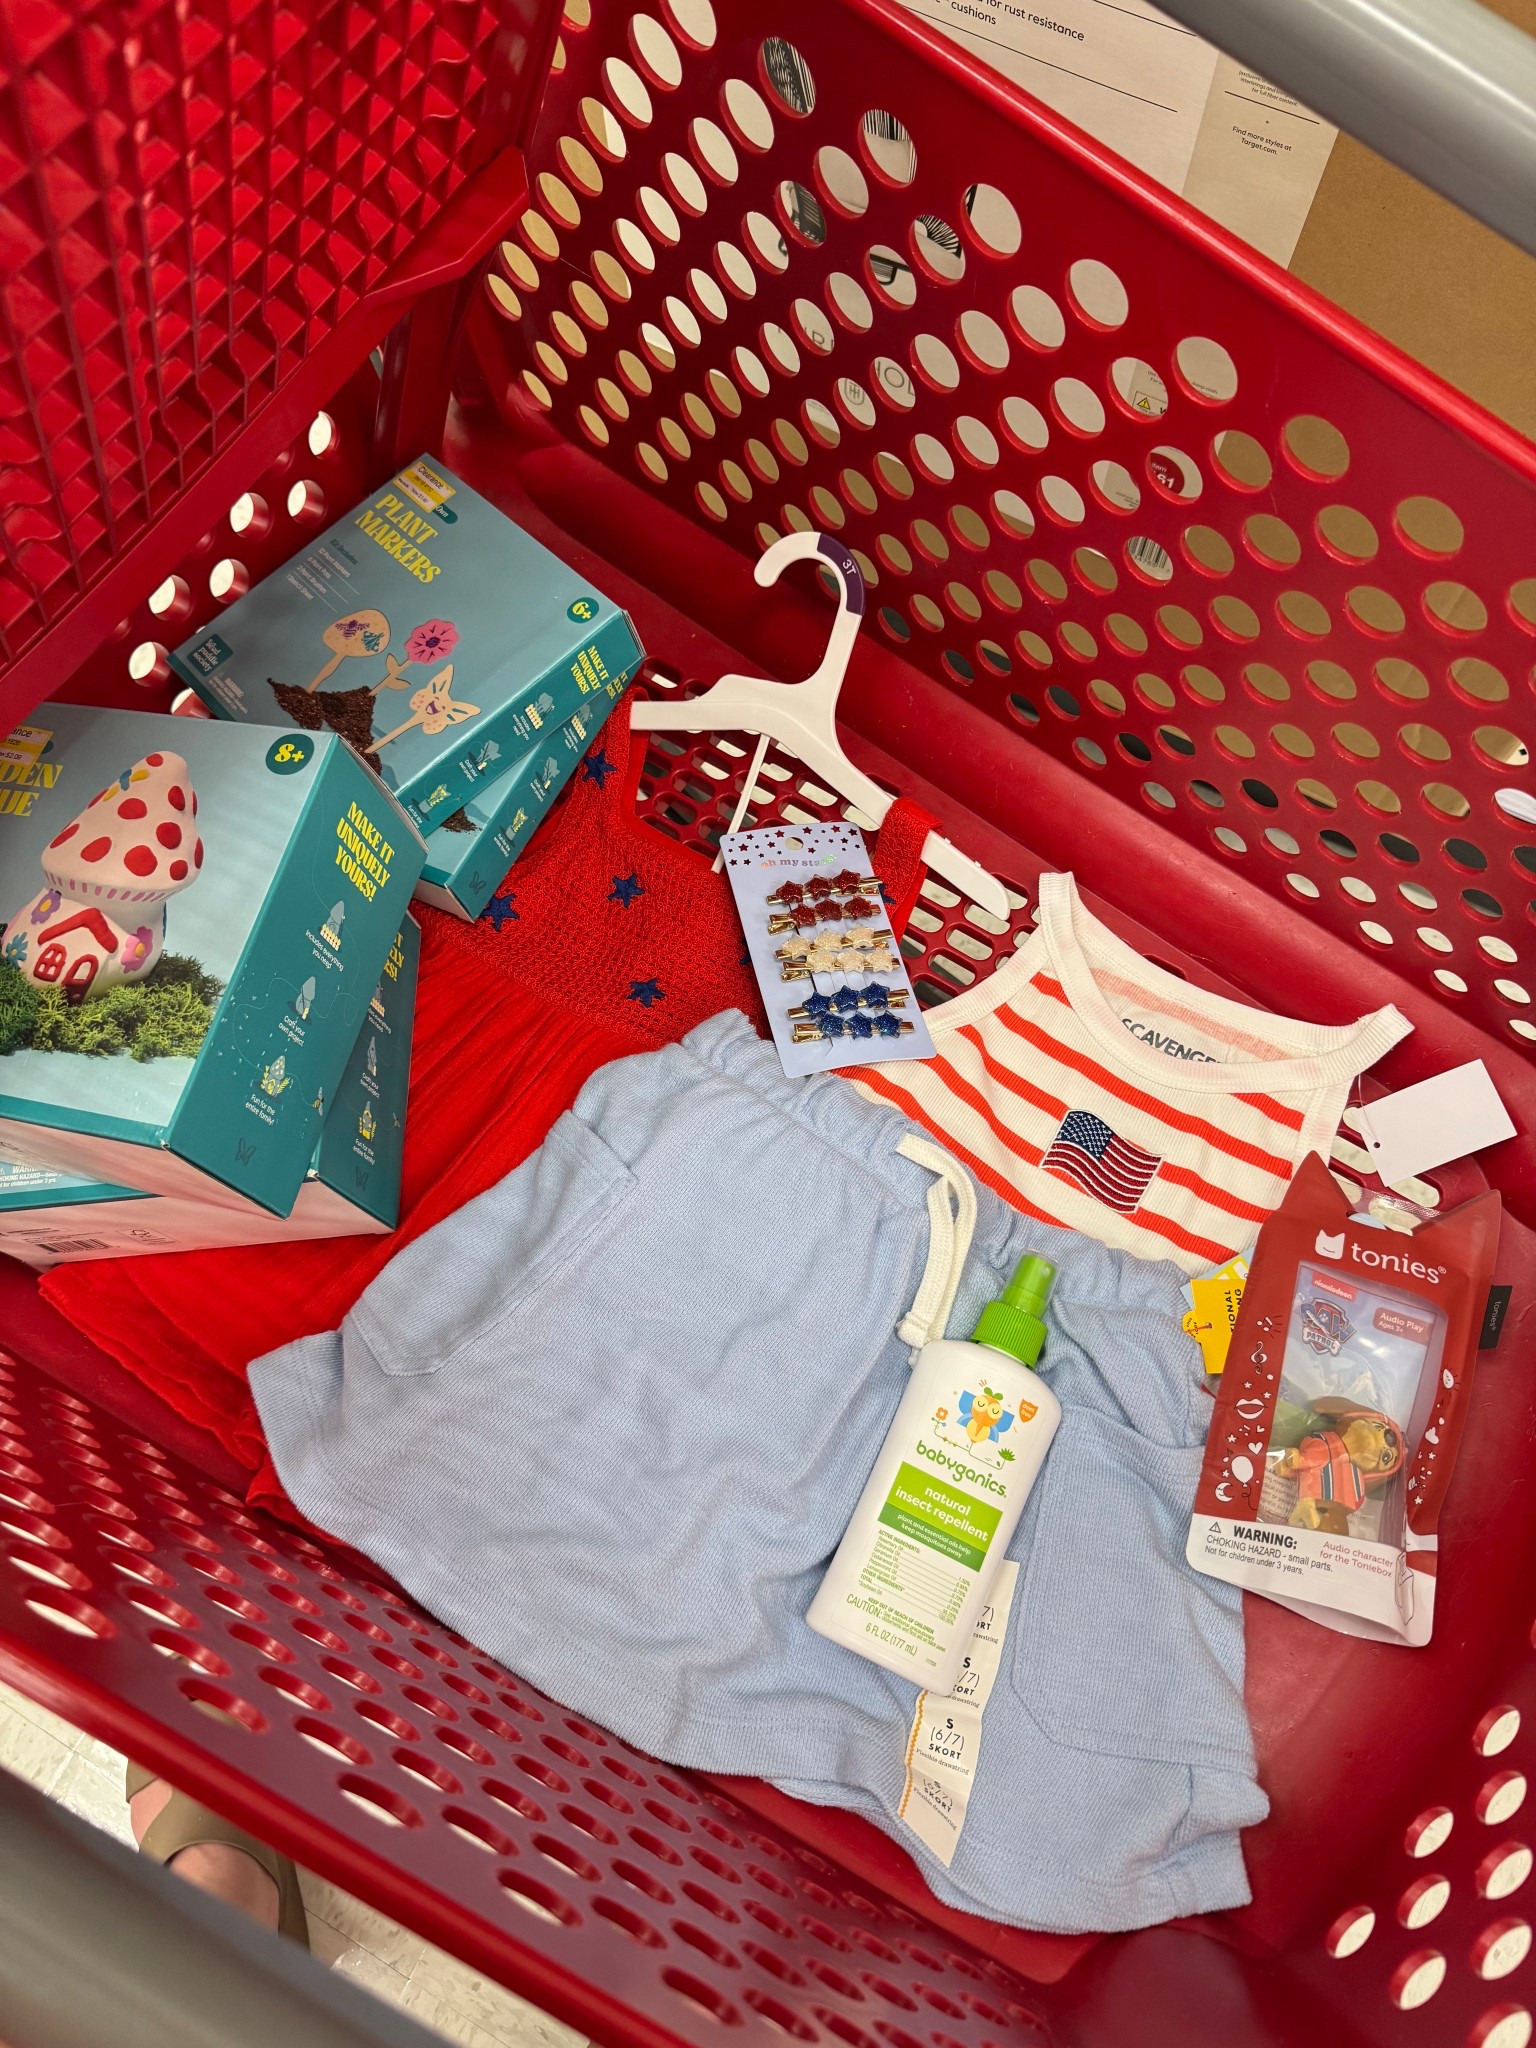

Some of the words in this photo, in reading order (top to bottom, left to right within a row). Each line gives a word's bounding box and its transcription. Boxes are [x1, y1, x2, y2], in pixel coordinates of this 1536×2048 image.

[951, 2, 996, 25] cushions
[1004, 4, 1025, 18] rust
[1028, 13, 1084, 42] resistance
[1232, 126, 1246, 135] Find
[1248, 132, 1264, 142] more
[1265, 138, 1283, 149] styles
[1241, 138, 1278, 155] Target.com.
[418, 466, 443, 489] Clearance
[375, 494, 438, 544] PLANT
[355, 510, 441, 582] MARKERS
[842, 559, 856, 574] 3T
[572, 601, 591, 619] 6+
[193, 652, 213, 672] society
[198, 647, 219, 666] puddle
[588, 645, 604, 672] MAKE
[599, 670, 609, 680] IT
[571, 662, 590, 694] YOURS!
[578, 651, 601, 690] UNIQUELY
[275, 744, 304, 763] 8+
[347, 801, 382, 851] MAKE
[380, 842, 395, 865] IT
[336, 817, 390, 888] UNIQUELY
[780, 860, 798, 868] my
[335, 845, 377, 902] YOURS!
[306, 929, 324, 950] Includes
[323, 948, 344, 972] everything
[312, 948, 320, 959] you
[320, 954, 332, 969] need
[278, 1022, 289, 1034] own
[288, 1030, 305, 1047] project
[284, 1015, 297, 1029] Craft
[295, 1025, 306, 1037] your
[245, 1102, 260, 1115] entire
[258, 1110, 274, 1126] family!
[251, 1094, 260, 1104] Fun
[259, 1099, 268, 1110] for
[267, 1105, 276, 1115] the
[1314, 1280, 1352, 1299] nickelodeon
[1301, 1303, 1357, 1343] PAW
[1378, 1321, 1394, 1330] Ages
[1381, 1312, 1404, 1326] Audio
[1406, 1321, 1424, 1333] Play
[1307, 1331, 1336, 1349] PATROL
[1021, 1409, 1032, 1418] free
[1023, 1403, 1034, 1413] deet
[925, 1486, 971, 1516] natural
[896, 1486, 932, 1513] insect
[933, 1507, 989, 1541] repellent
[878, 1530, 893, 1540] ACTIVE
[893, 1536, 920, 1554] INGREDIENTS:
[897, 1514, 913, 1525] plant
[913, 1521, 924, 1530] and
[924, 1526, 948, 1542] essential
[949, 1538, 959, 1548] oils
[959, 1543, 971, 1555] help
[902, 1523, 915, 1534] keep
[916, 1530, 947, 1550] mosquitoes
[947, 1546, 962, 1558] away
[1233, 1525, 1298, 1550] WARNING:
[1205, 1546, 1217, 1556] Not
[1218, 1547, 1227, 1557] for
[1229, 1550, 1255, 1563] children
[1256, 1557, 1276, 1568] under
[1277, 1561, 1282, 1569] 3
[1282, 1564, 1304, 1576] years.
[1207, 1534, 1246, 1552] CHOKING
[1248, 1544, 1282, 1559] HAZARD
[1288, 1554, 1309, 1566] small
[1311, 1559, 1333, 1572] parts.
[1320, 1550, 1332, 1560] for
[1334, 1554, 1350, 1565] the
[1352, 1559, 1392, 1578] Toniebox
[1323, 1541, 1350, 1554] Audio
[1352, 1549, 1393, 1568] character
[860, 1574, 873, 1584] TOTAL
[863, 1568, 876, 1578] OTHER
[847, 1594, 883, 1619] CAUTION:
[879, 1602, 888, 1610] OUT
[894, 1609, 908, 1620] REACH
[914, 1620, 934, 1634] CHILDREN
[866, 1622, 872, 1632] 6
[872, 1625, 879, 1637] FL
[881, 1630, 890, 1641] OZ
[890, 1634, 905, 1648] (177
[905, 1643, 918, 1656] mL)
[973, 1633, 998, 1644] rawstring
[963, 1657, 971, 1668] S
[957, 1671, 980, 1688] /7)
[946, 1718, 954, 1729] S
[931, 1727, 964, 1751] (6/7)
[916, 1747, 938, 1763] Flexible
[938, 1758, 970, 1775] drawstring
[929, 1743, 961, 1760] SKORT
[913, 1786, 932, 1807] Flexible
[932, 1803, 957, 1831] drawstring
[924, 1787, 951, 1813] SKORT
